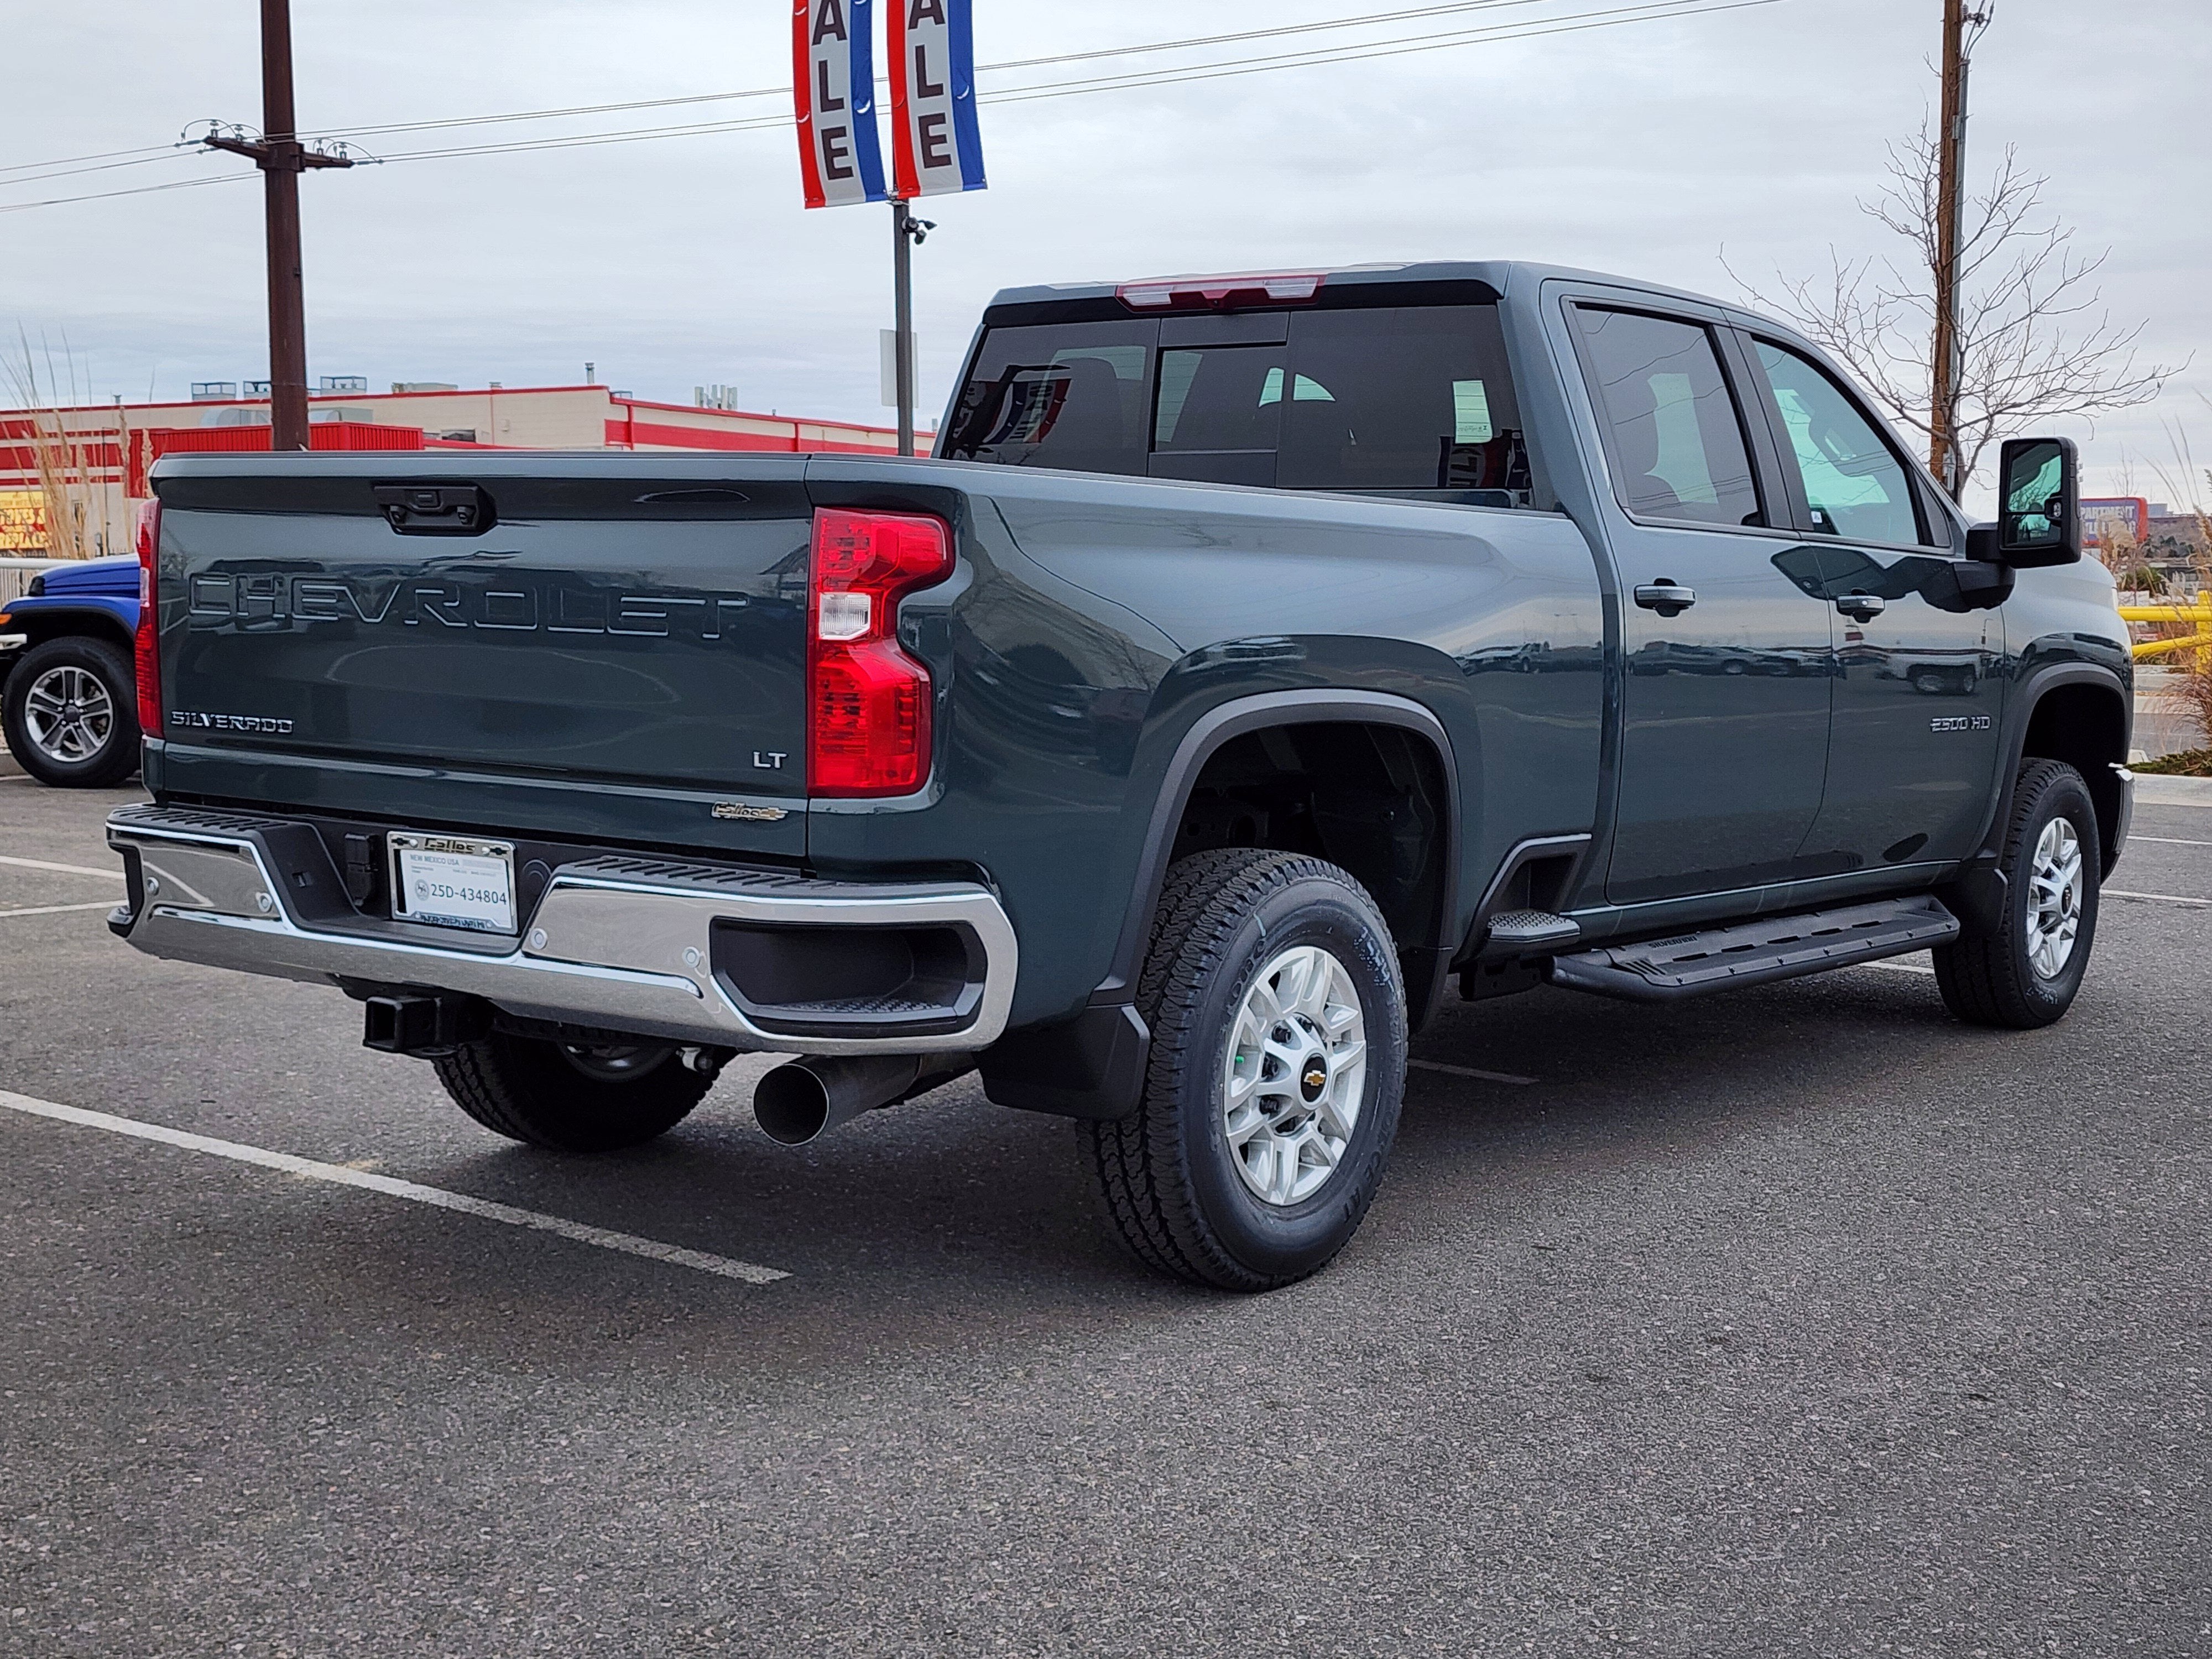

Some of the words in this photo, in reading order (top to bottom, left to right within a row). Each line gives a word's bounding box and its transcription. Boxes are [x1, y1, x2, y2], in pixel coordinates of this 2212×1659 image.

[189, 572, 748, 639] CHEVROLET
[171, 711, 294, 734] SILVERADO
[1929, 717, 1968, 732] 2500
[1970, 716, 1990, 730] HD
[753, 751, 787, 769] LT
[424, 855, 446, 864] MEXICO
[430, 883, 507, 905] 25D-434804
